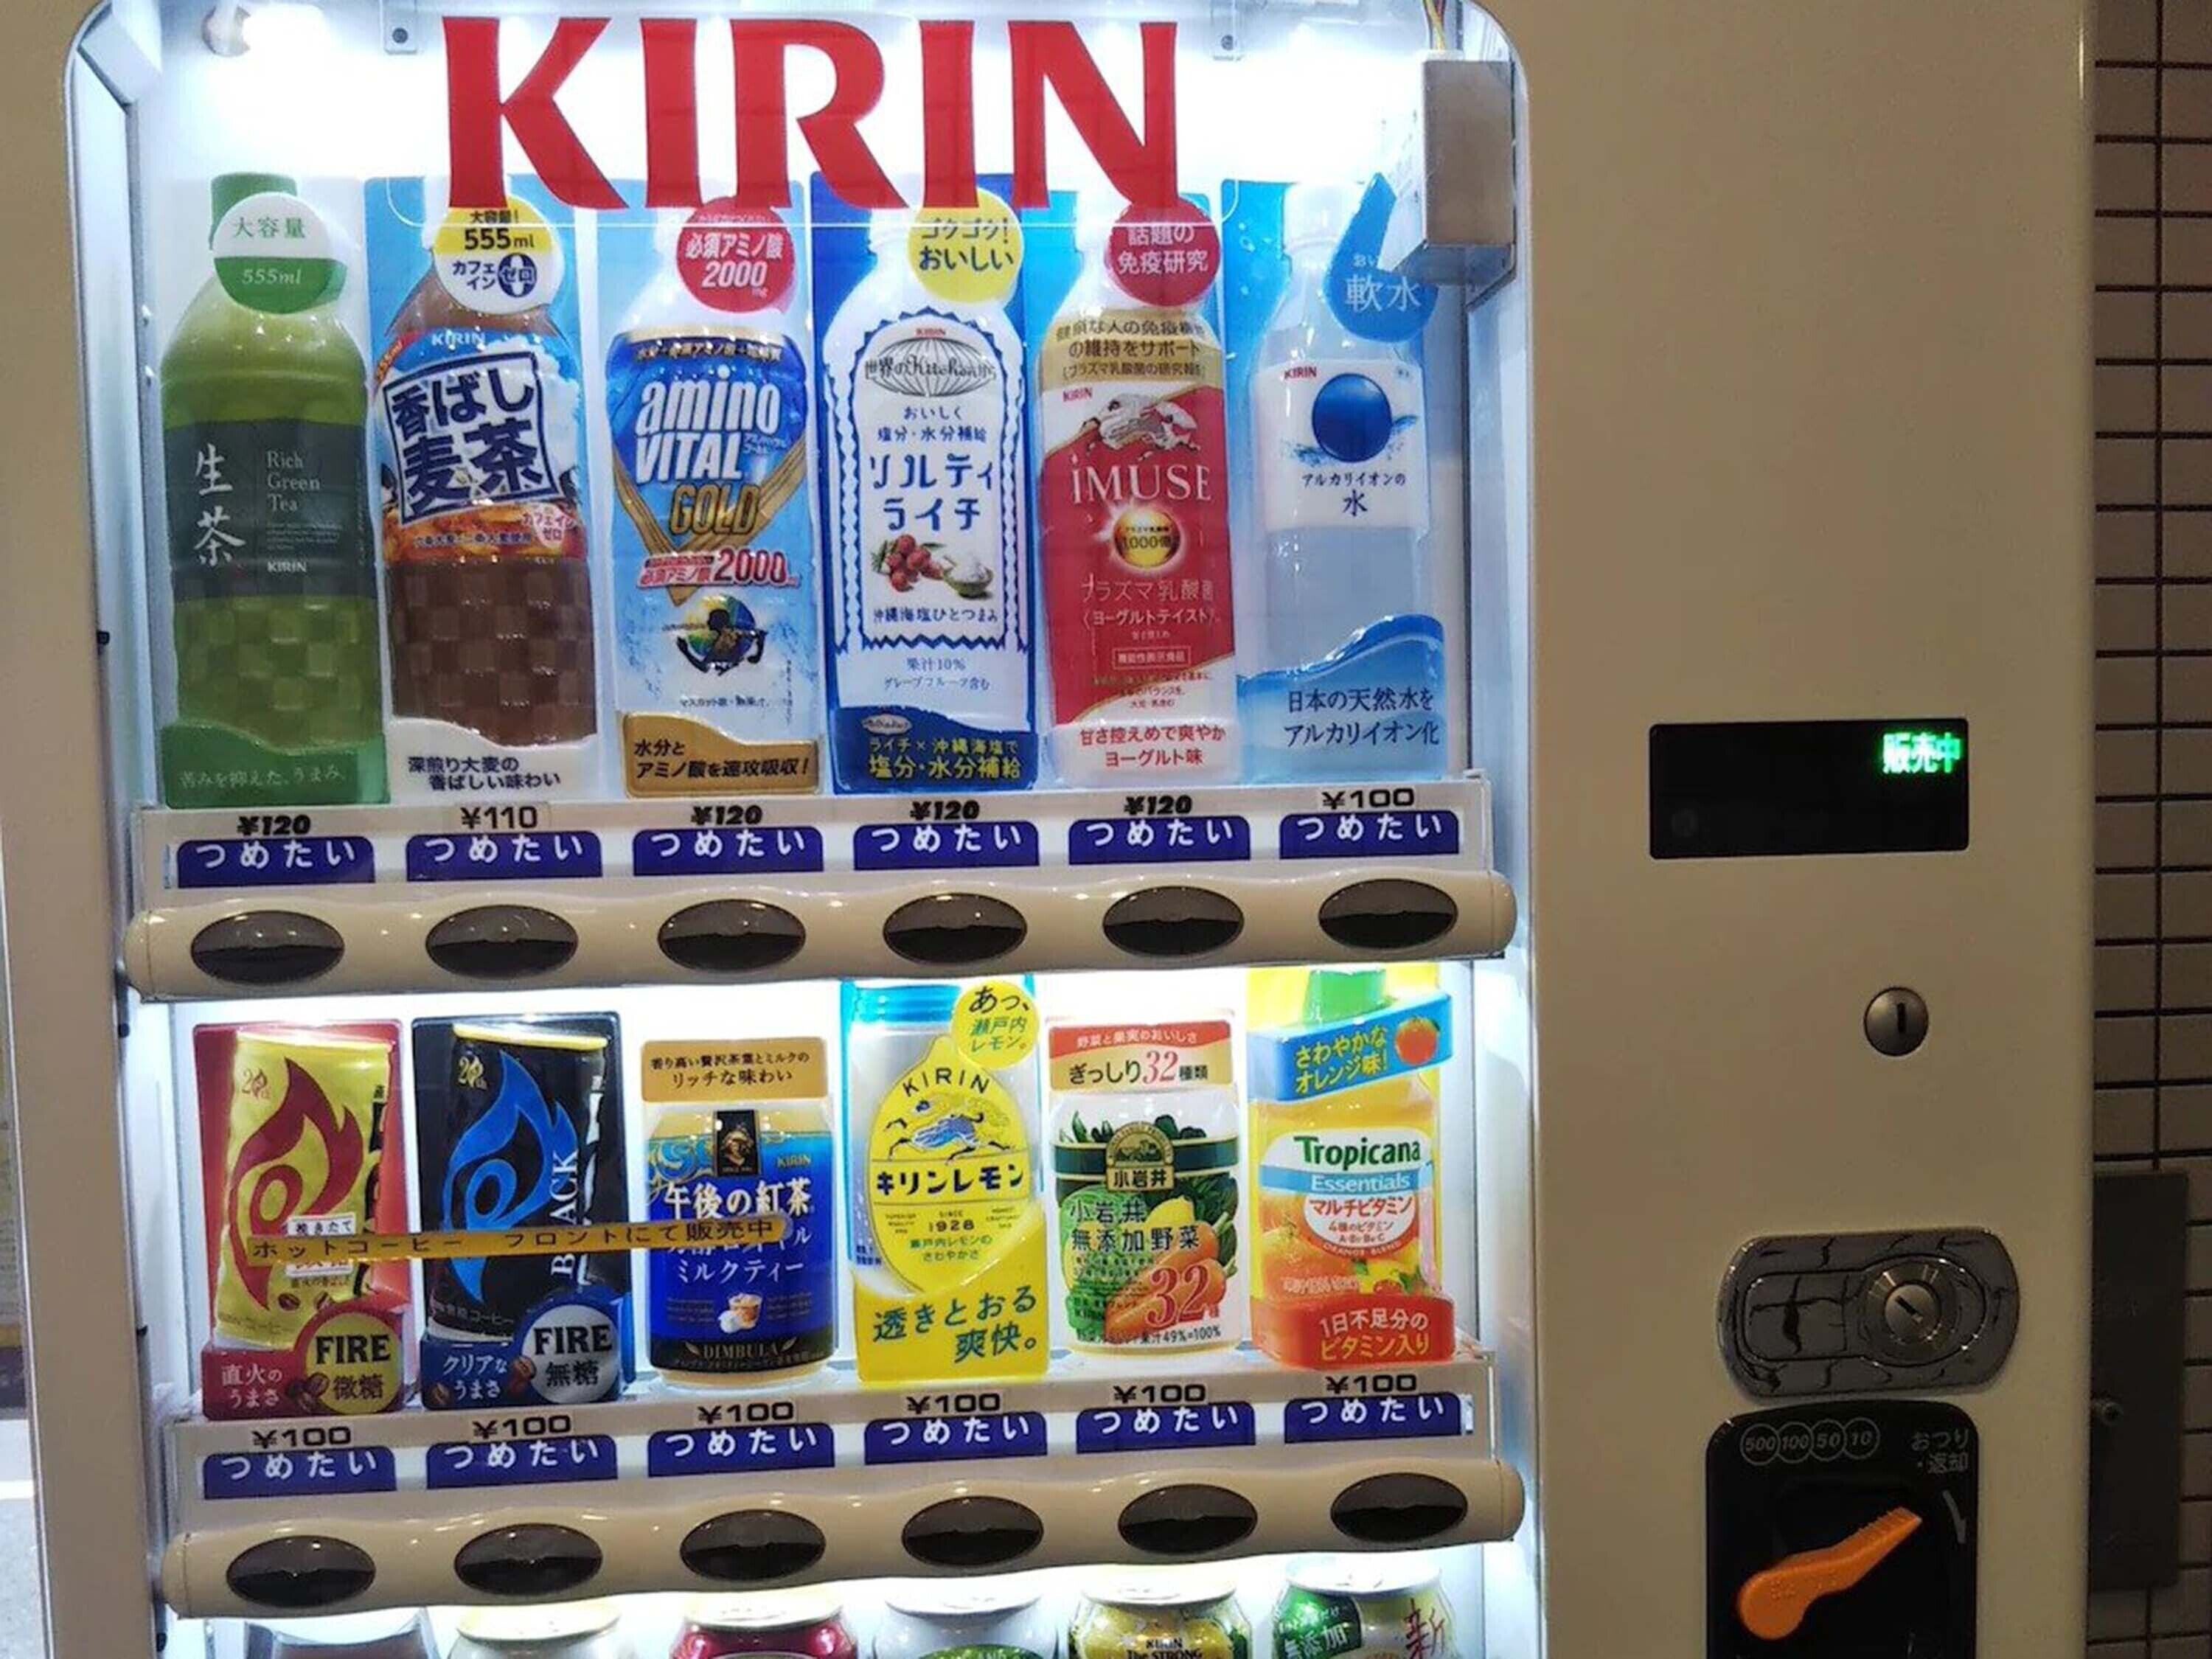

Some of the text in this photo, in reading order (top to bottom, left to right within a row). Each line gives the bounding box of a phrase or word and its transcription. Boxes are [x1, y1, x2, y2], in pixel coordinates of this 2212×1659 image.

[442, 17, 1178, 209] KIRIN
[233, 217, 306, 239] 大容量
[1127, 225, 1194, 246] 話題の
[685, 232, 785, 259] 必須アミノ酸
[452, 261, 495, 276] カフェ
[919, 246, 1015, 272] おいしい
[1118, 250, 1209, 275] 免疫研究
[242, 268, 302, 285] 555ml
[502, 267, 533, 282] ゼロ
[702, 260, 768, 288] 2000
[1345, 274, 1422, 313] 軟水
[1069, 340, 1200, 358] の維持をサポート
[1284, 366, 1317, 379] KIRIN
[392, 369, 535, 442] 香ばし
[636, 365, 780, 436] amino
[904, 407, 962, 420] おいしく
[267, 451, 303, 468] Rich
[403, 417, 543, 516] 麦茶
[636, 432, 742, 485] VITAL
[267, 472, 320, 490] Green
[1302, 473, 1406, 487] アルカリイオンの
[194, 443, 246, 567] 生茶
[267, 494, 298, 512] Tea
[669, 484, 762, 535] GOLD
[883, 498, 981, 531] ライチ
[1343, 489, 1368, 516] 水
[267, 561, 307, 573] KIRIN
[714, 548, 787, 583] 2000
[873, 607, 998, 623] 沖縄海塩ひとつまみ
[1289, 687, 1433, 712] 日本の天然水を
[1080, 725, 1226, 746] 甘さ控えめで爽やか
[1284, 722, 1439, 746] アルカリイオン化
[634, 739, 685, 757] 水分と
[1105, 749, 1203, 767] ヨーグルト味
[1882, 732, 1961, 774] 販売中
[408, 756, 519, 774] 深煎り大麦の
[869, 755, 1021, 779] 塩分・水分補給
[428, 772, 560, 790] 香ばしい味わい
[911, 801, 980, 821] ¥120
[1124, 794, 1192, 815] ¥120
[1322, 788, 1415, 810] ¥100
[237, 815, 310, 836] ¥120
[461, 806, 537, 830] ¥110
[692, 805, 762, 825] ¥120
[1298, 813, 1441, 841] つめたい
[653, 830, 804, 858] つめたい
[872, 824, 1021, 852] つめたい
[1087, 818, 1233, 846] つめたい
[197, 841, 355, 869] つめたい
[425, 835, 583, 863] つめたい
[969, 987, 1029, 1014] あっ、
[970, 1016, 1027, 1037] 瀬戸内
[1295, 1024, 1386, 1069] さわやかな
[673, 1069, 793, 1088] リッチな味わい
[902, 1068, 990, 1097] KIRIN
[1293, 1137, 1421, 1171] Tropicana
[877, 1164, 1023, 1196] キリンレモン
[1114, 1171, 1167, 1188] 小岩井
[1311, 1173, 1410, 1193] Essentials
[664, 1178, 811, 1220] 午後の紅茶
[1310, 1196, 1413, 1217] マルチビタミン
[550, 1150, 579, 1275] BACK
[1071, 1200, 1145, 1224] 小岩井
[928, 1220, 975, 1233] 1928
[1071, 1225, 1200, 1251] 無添加野菜
[254, 1239, 461, 1258] ホットコーヒー
[505, 1220, 773, 1248] フロントにて販売中
[678, 1259, 804, 1283] ミルクティー
[1145, 1265, 1209, 1328] 32
[873, 1286, 1036, 1342] 透きとおる
[1321, 1308, 1429, 1338] 1日不足分の
[316, 1335, 390, 1364] FIRE
[534, 1325, 612, 1354] FIRE
[954, 1321, 1036, 1363] 爽快。
[1321, 1333, 1430, 1361] ビタミン入り
[222, 1364, 282, 1385] 直火の
[443, 1354, 507, 1375] クリアな
[546, 1363, 598, 1386] 無糖
[333, 1374, 383, 1399] 微糖
[454, 1380, 501, 1400] うまさ
[1113, 1384, 1206, 1404] ¥100
[1326, 1374, 1417, 1394] ¥100
[230, 1388, 279, 1408] うまさ
[907, 1394, 1001, 1415] ¥100
[698, 1402, 794, 1425] ¥100
[1094, 1406, 1238, 1435] つめたい
[1302, 1397, 1444, 1425] つめたい
[252, 1427, 351, 1449] ¥100
[473, 1415, 571, 1439] ¥100
[883, 1417, 1029, 1445] つめたい
[667, 1427, 817, 1456] つめたい
[1745, 1430, 1872, 1453] 500 100 50 10
[1910, 1429, 1969, 1451] おつり
[222, 1452, 376, 1480] つめたい
[445, 1439, 598, 1469] つめたい
